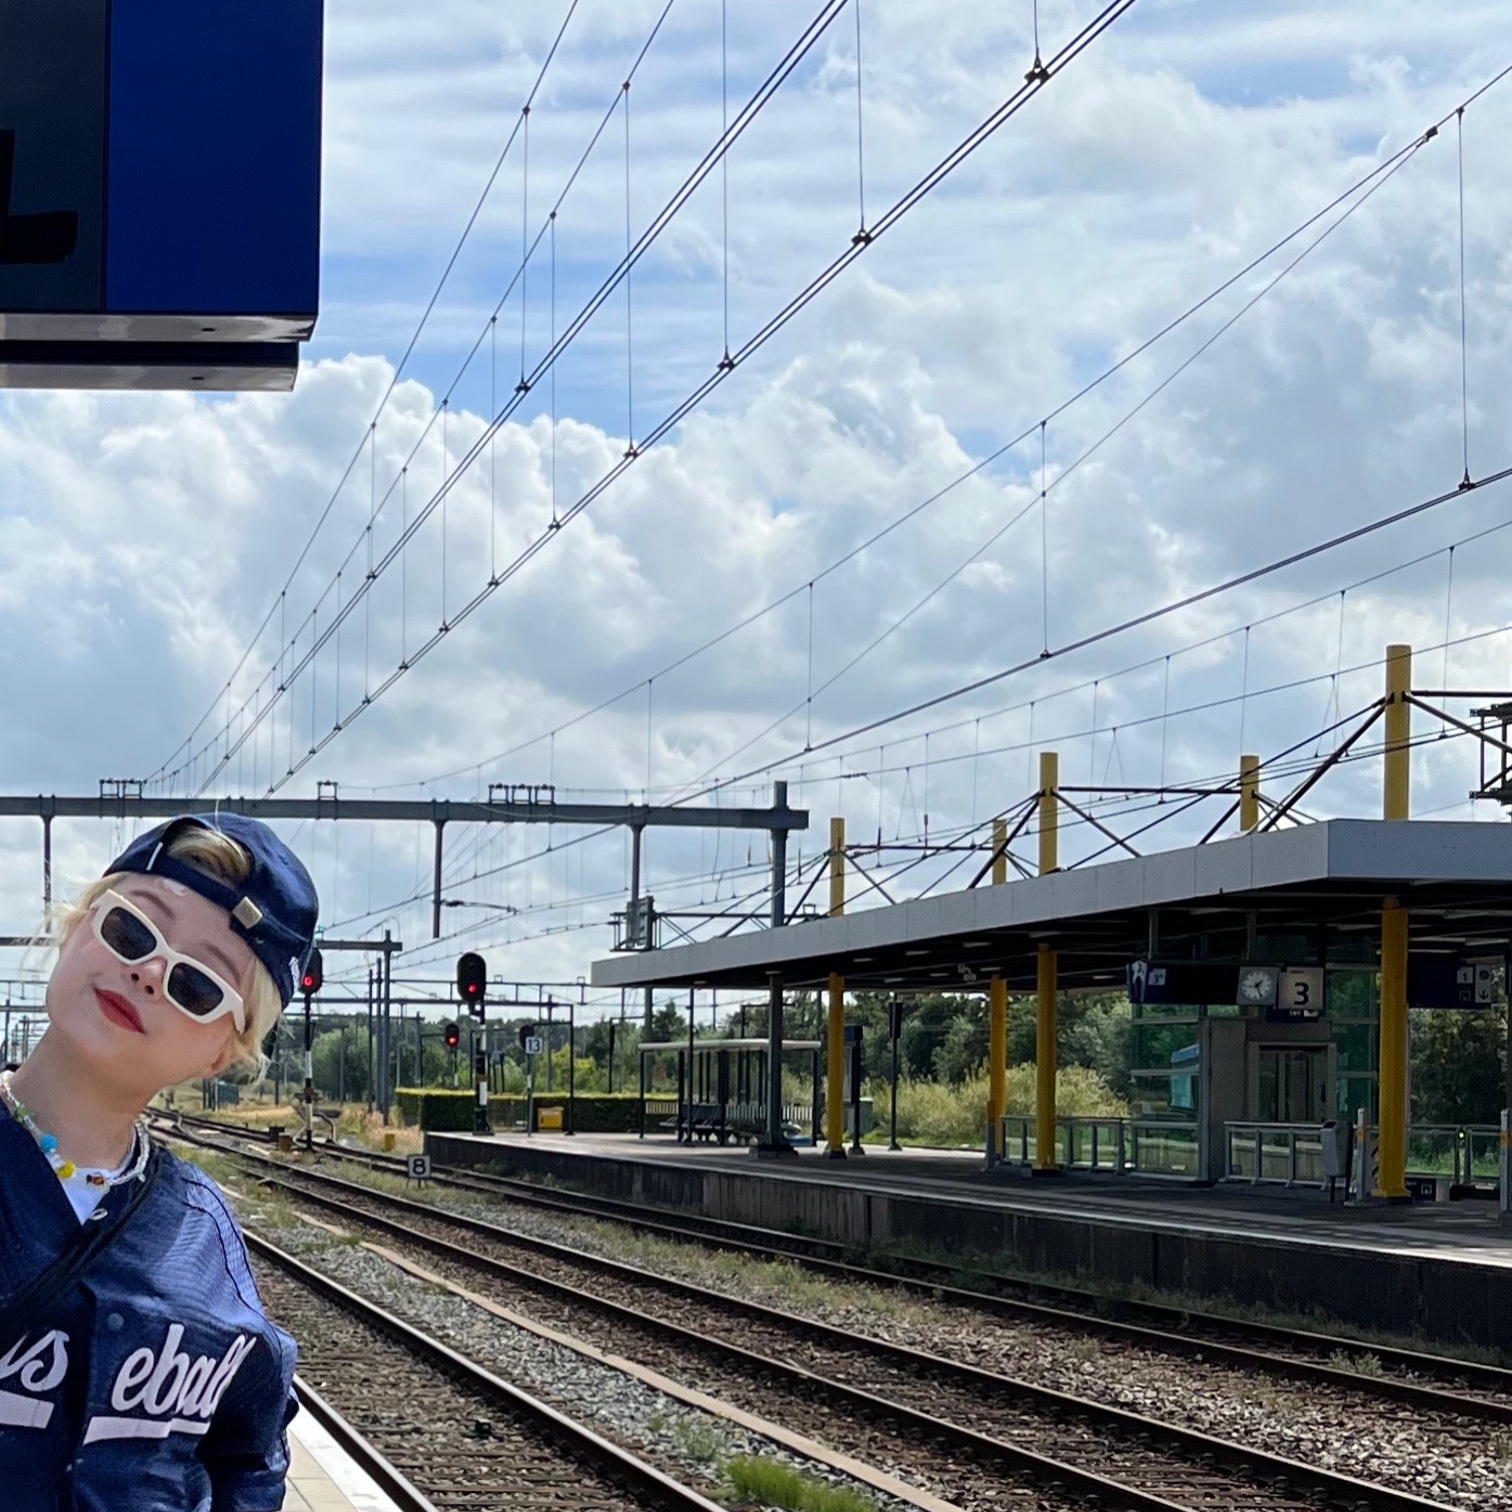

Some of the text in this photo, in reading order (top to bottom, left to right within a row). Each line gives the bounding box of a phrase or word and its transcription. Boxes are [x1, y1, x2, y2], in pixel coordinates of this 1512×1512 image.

[1293, 981, 1309, 1006] 3
[528, 1038, 541, 1051] 13
[412, 1157, 426, 1176] 8
